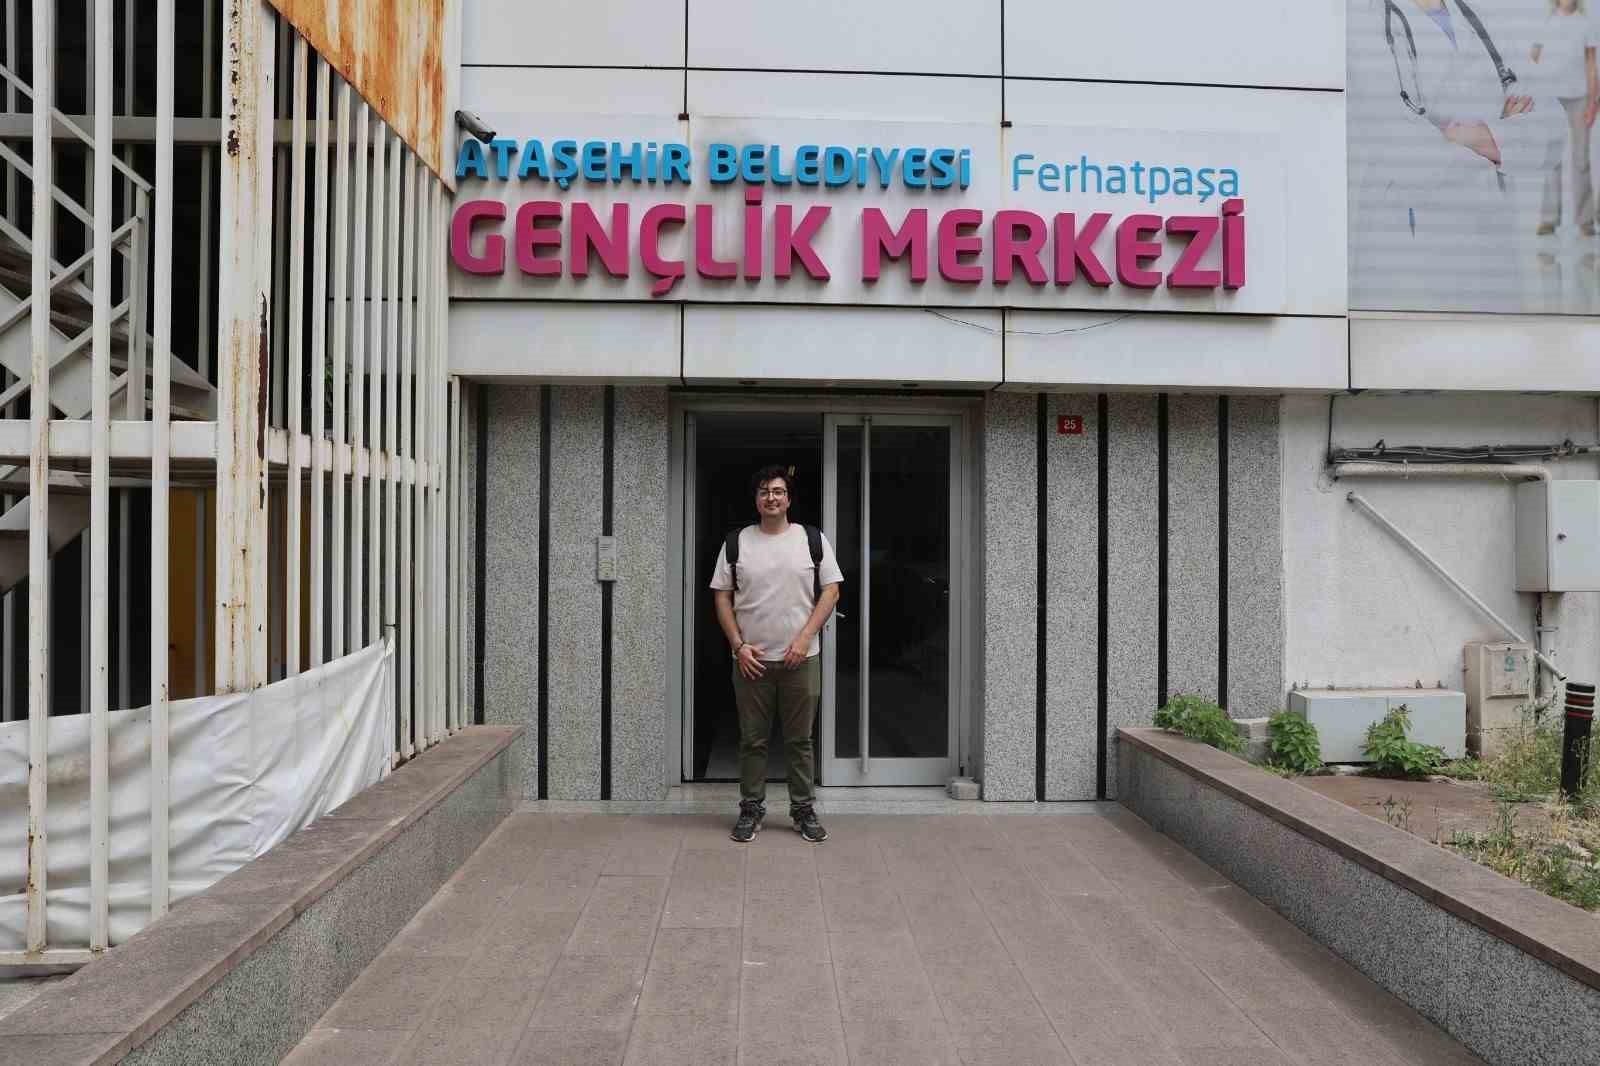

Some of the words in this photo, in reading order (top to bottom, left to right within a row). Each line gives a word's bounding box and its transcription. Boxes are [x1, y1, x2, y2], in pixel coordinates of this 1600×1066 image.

[1012, 154, 1239, 203] Ferhatpaşa
[450, 186, 831, 297] GENÇLİK
[861, 198, 1246, 290] MERKEZİ
[1063, 419, 1077, 430] 25
